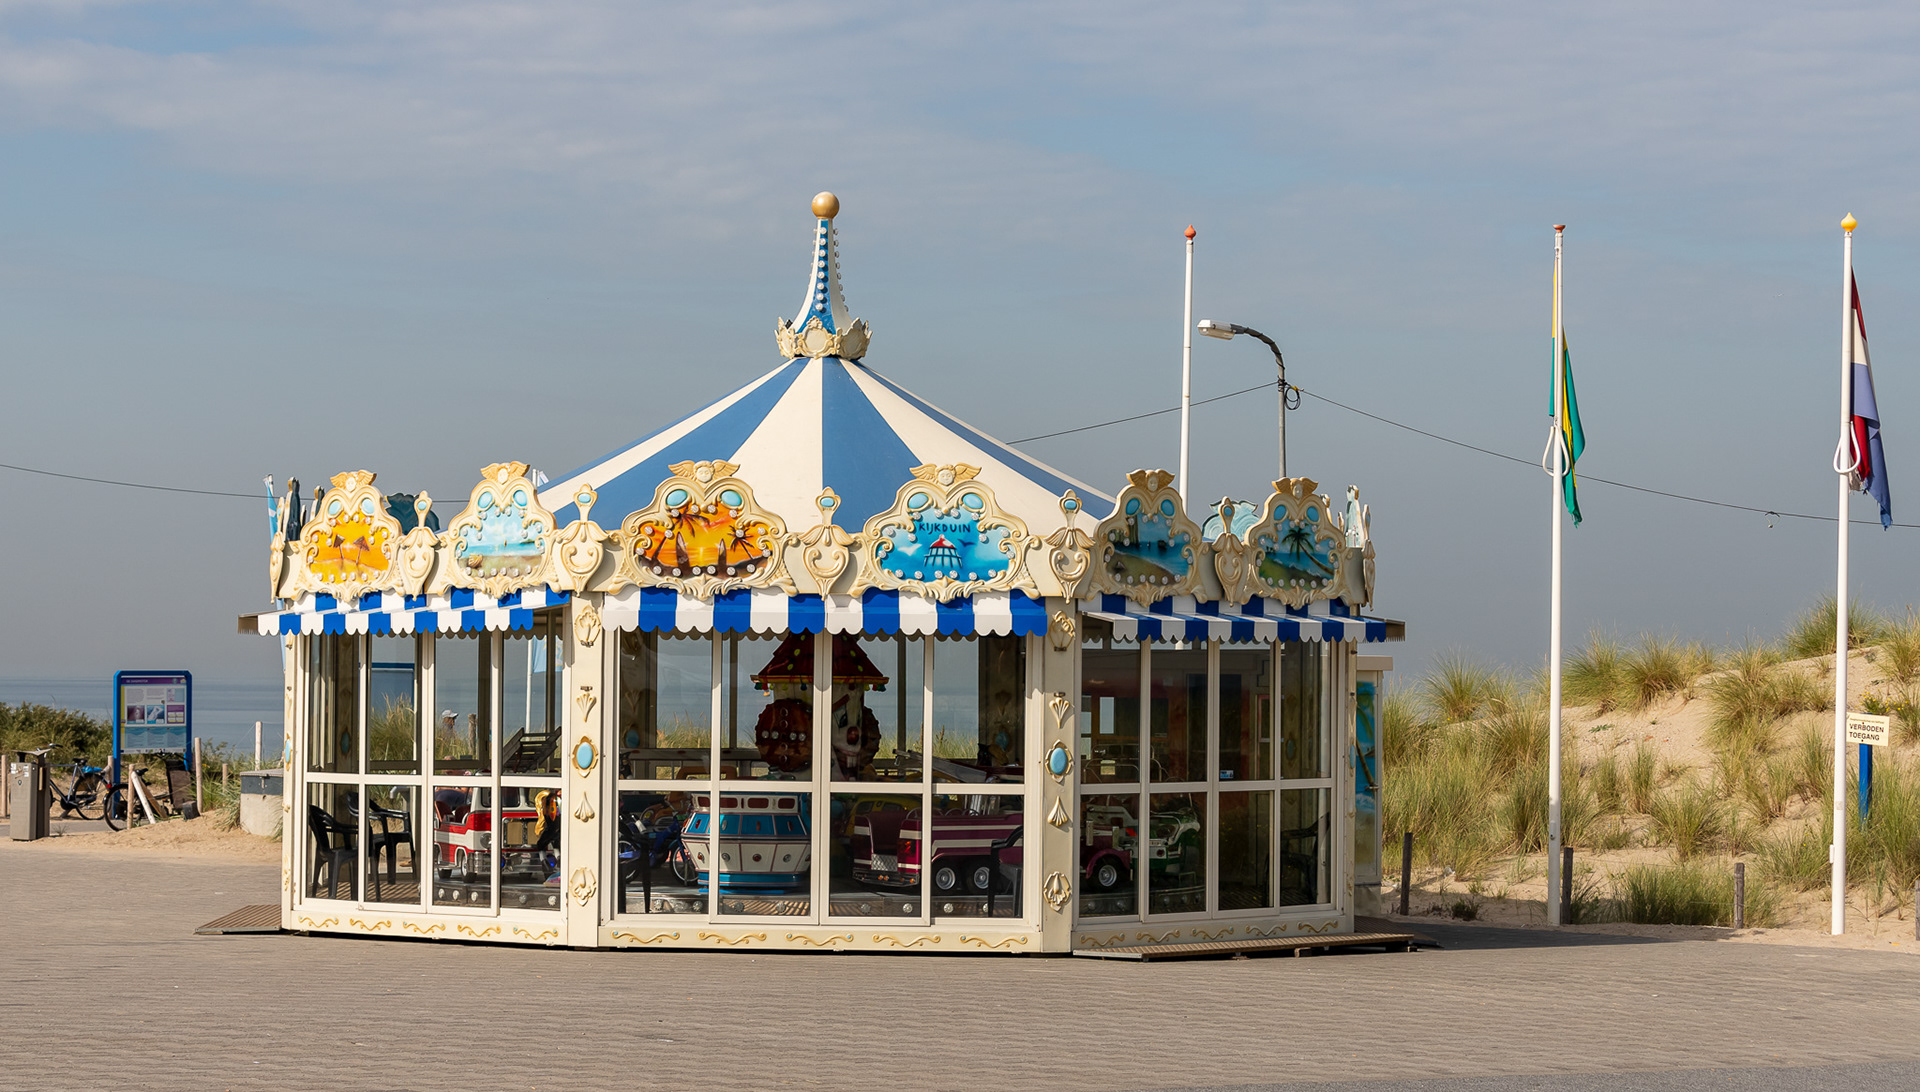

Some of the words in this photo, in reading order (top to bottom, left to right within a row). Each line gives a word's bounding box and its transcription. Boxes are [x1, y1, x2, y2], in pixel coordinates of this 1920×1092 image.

[919, 523, 970, 534] KIJKDUIN
[1849, 724, 1884, 732] VERBODEN
[1849, 732, 1879, 740] TOEGANG
